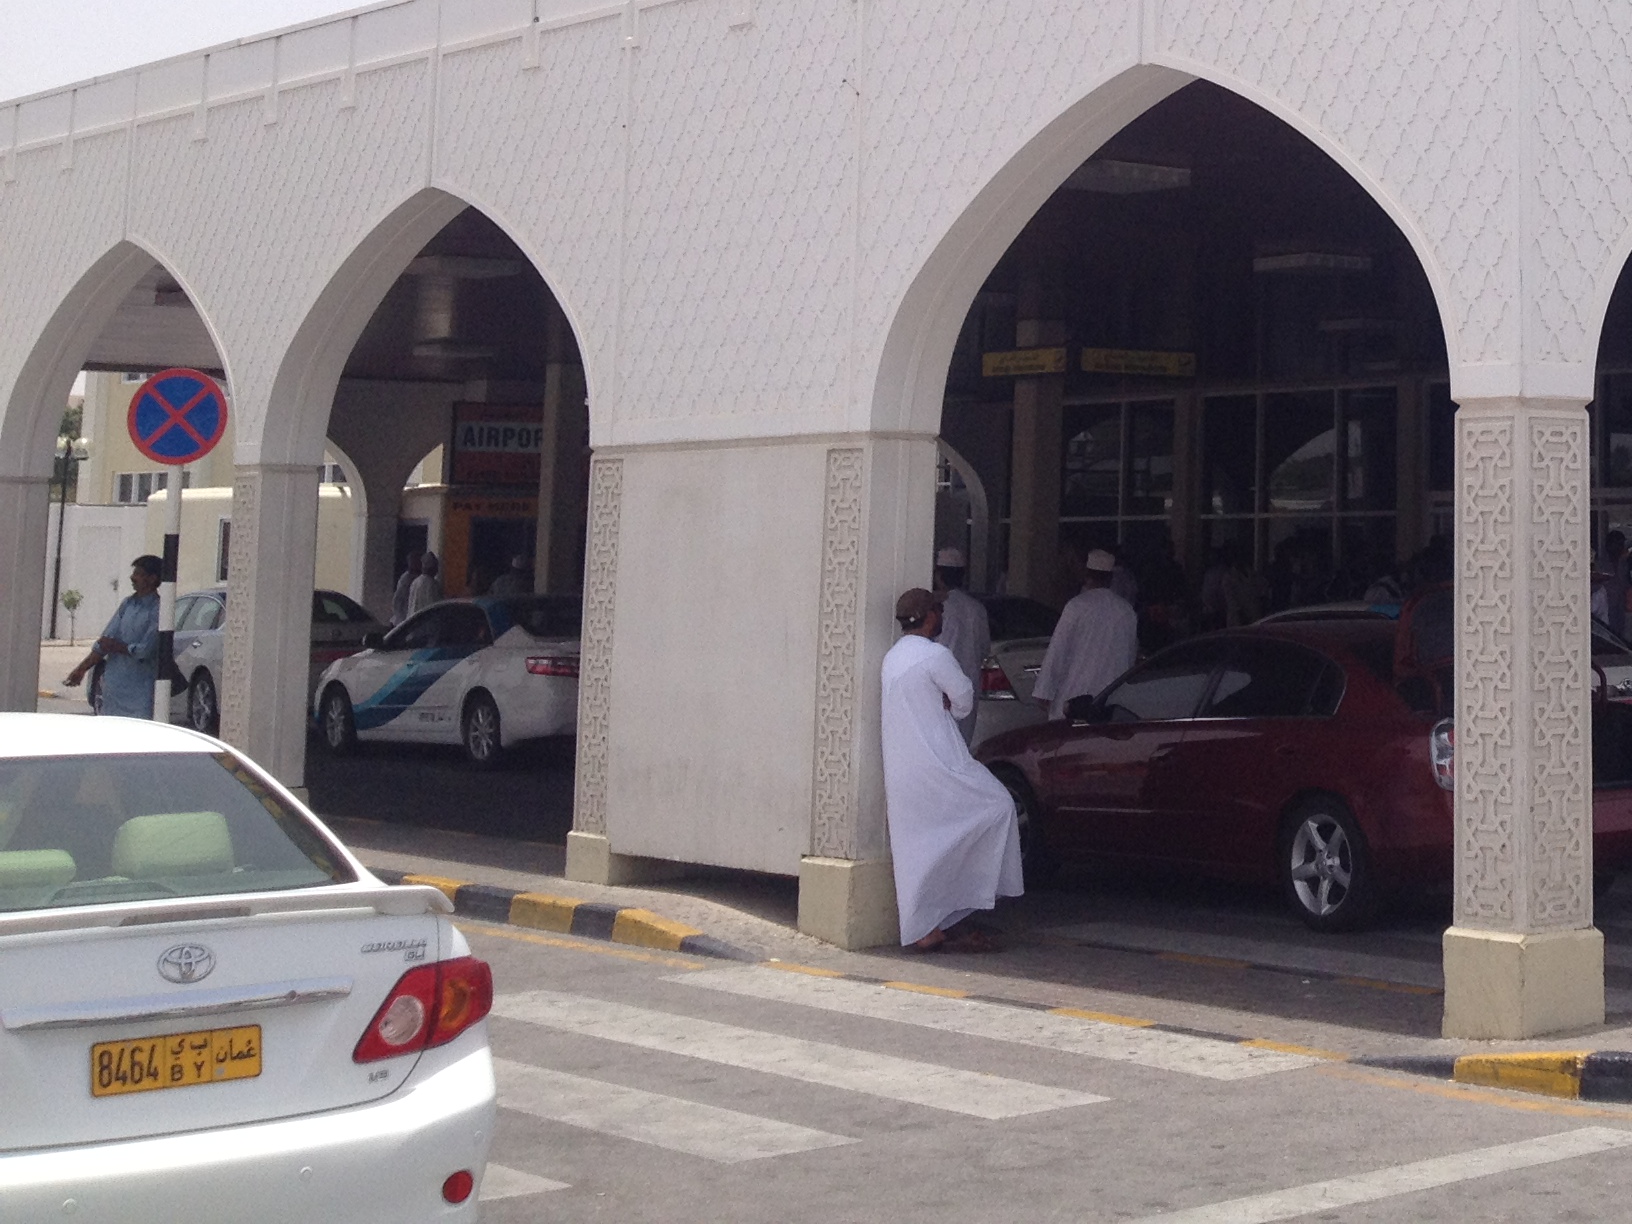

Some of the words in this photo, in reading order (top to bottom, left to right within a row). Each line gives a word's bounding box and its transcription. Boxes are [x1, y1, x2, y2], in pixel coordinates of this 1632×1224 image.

[98, 1043, 159, 1088] 8464
[170, 1063, 184, 1082] B
[194, 1060, 205, 1079] Y
